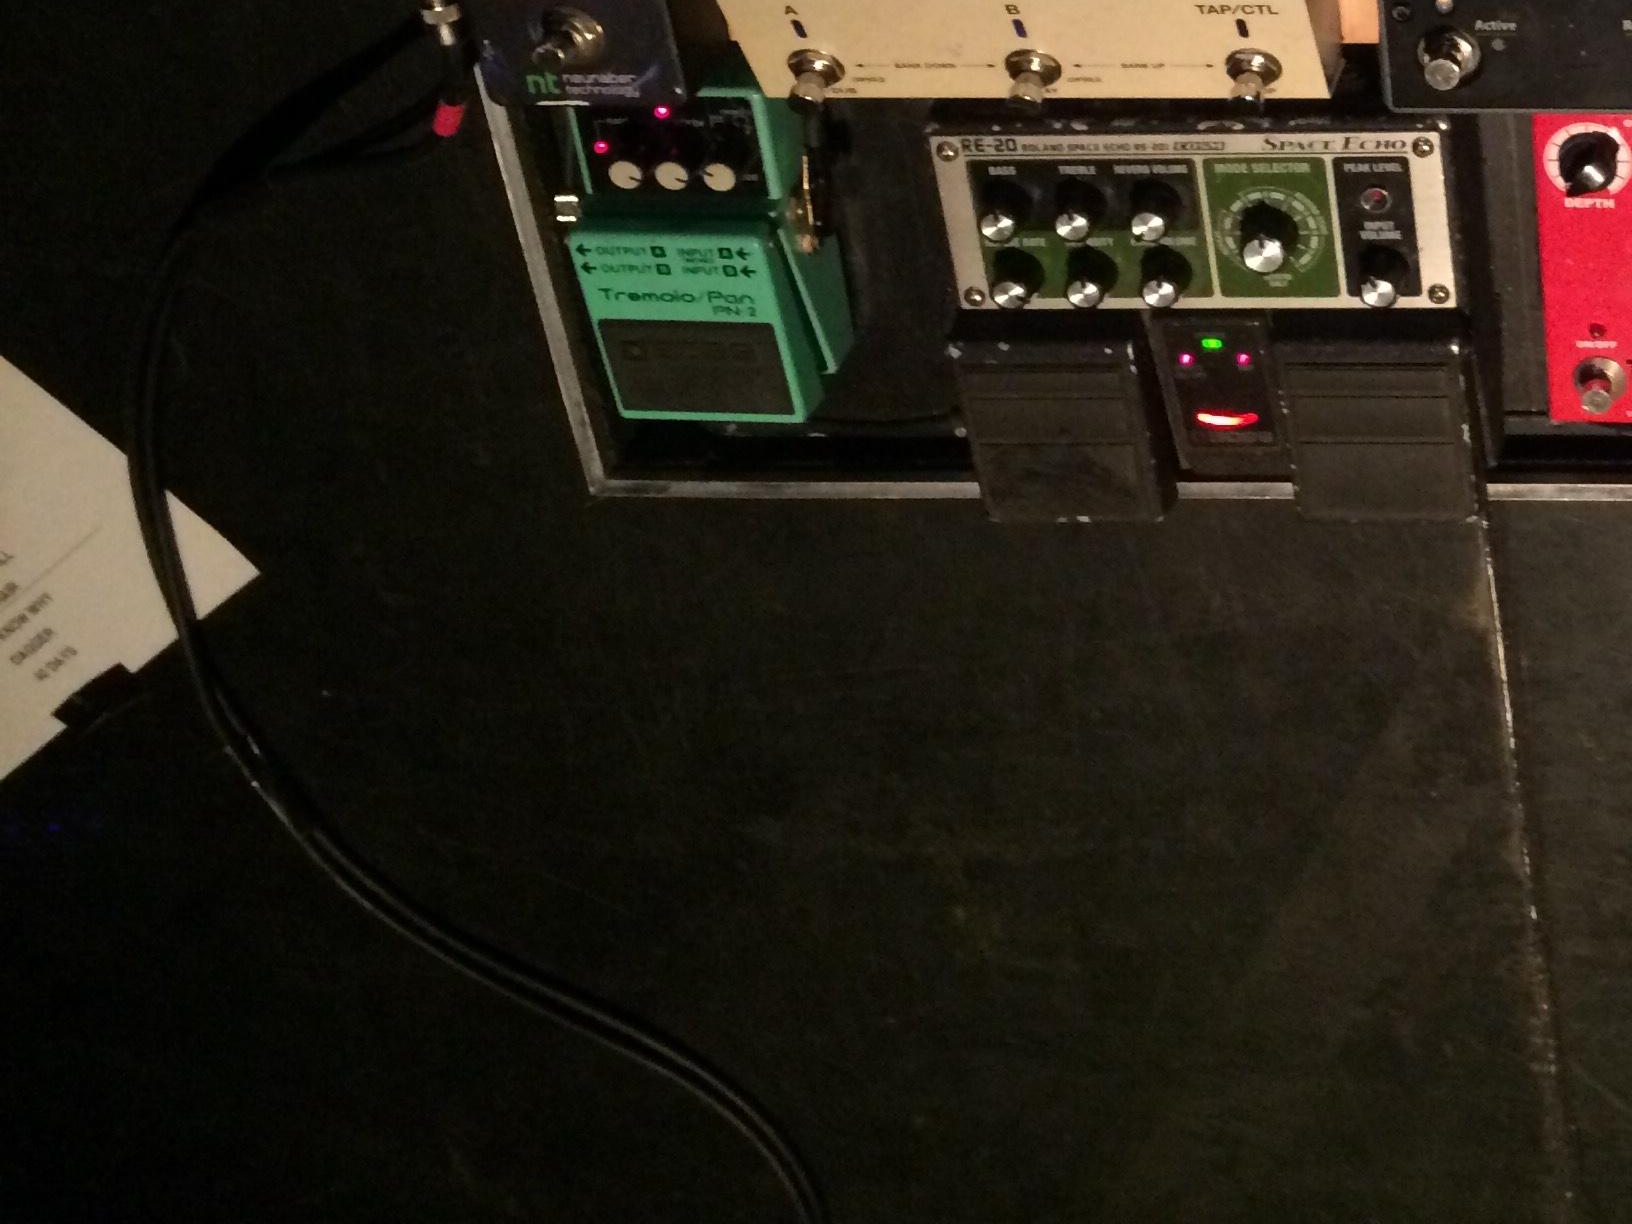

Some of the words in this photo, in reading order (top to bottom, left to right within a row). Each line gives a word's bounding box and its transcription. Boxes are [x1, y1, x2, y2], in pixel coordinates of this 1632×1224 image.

[783, 5, 799, 16] A
[1004, 4, 1021, 16] B
[1194, 4, 1280, 17] TAP/CTL
[525, 73, 562, 95] nt
[961, 137, 1018, 153] RE-20
[1563, 197, 1616, 210] DEPTH
